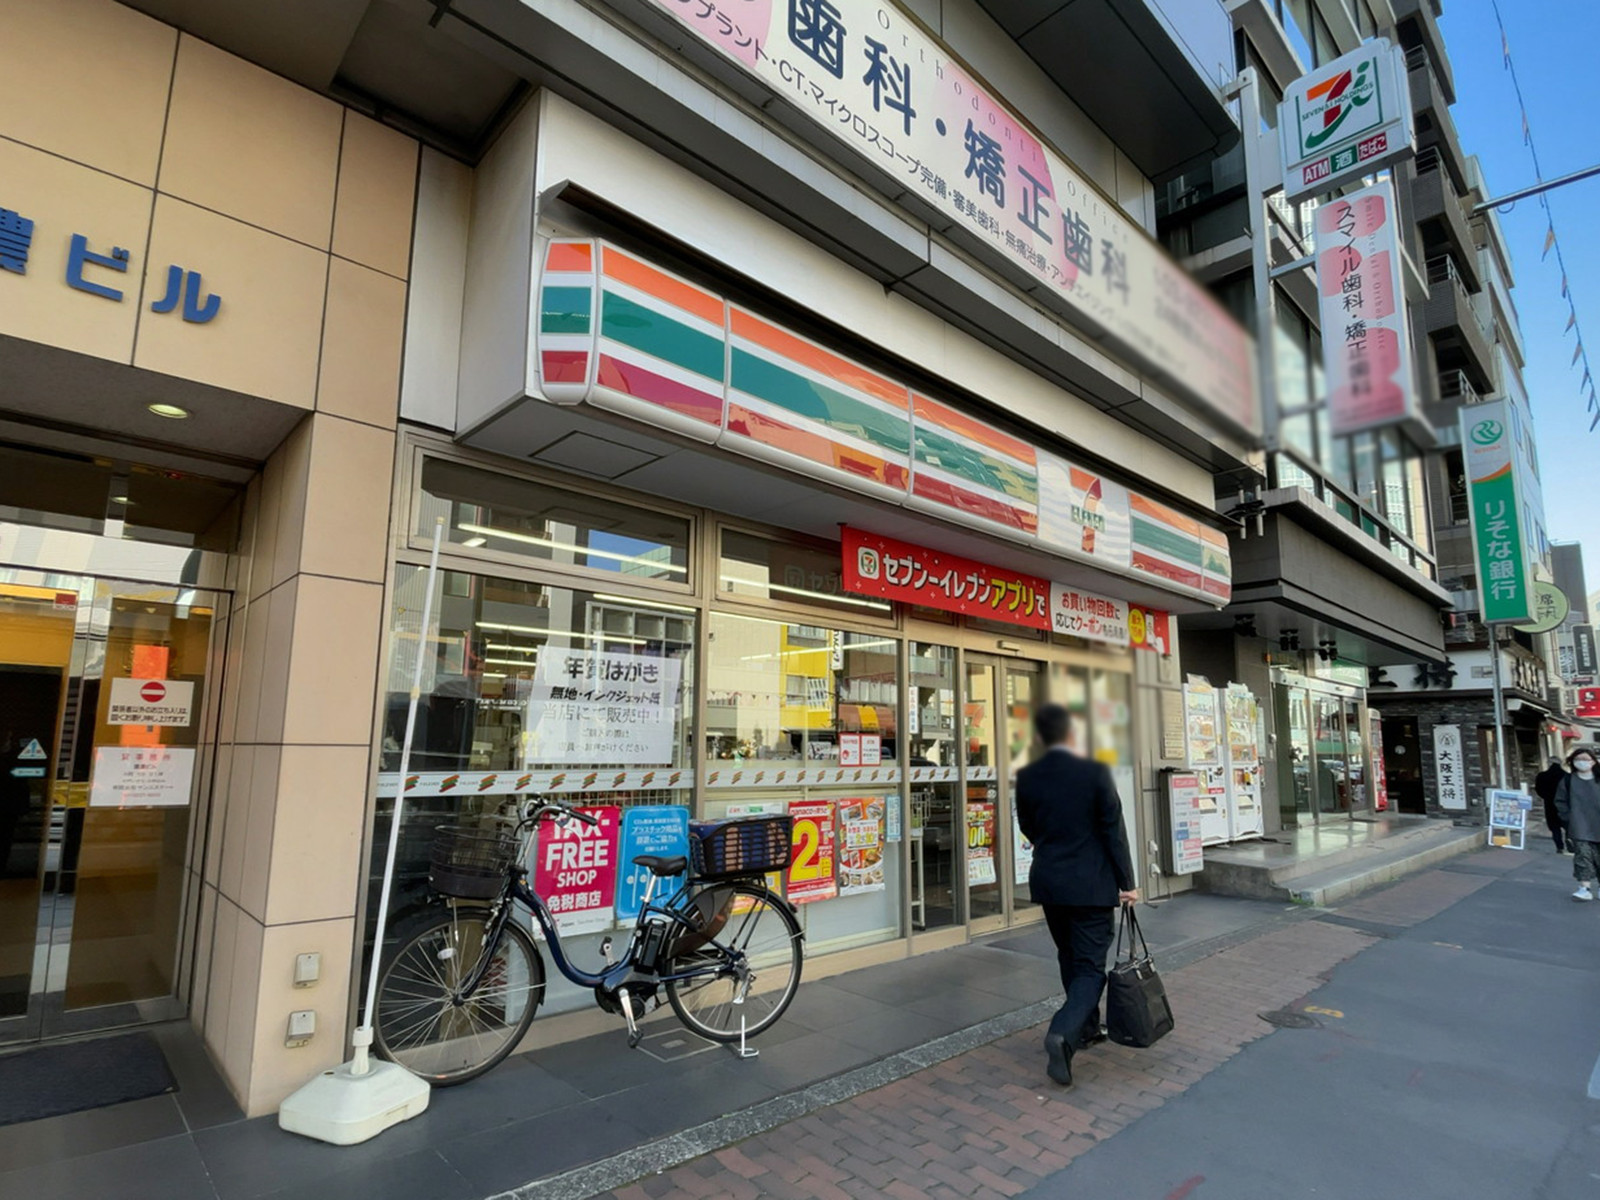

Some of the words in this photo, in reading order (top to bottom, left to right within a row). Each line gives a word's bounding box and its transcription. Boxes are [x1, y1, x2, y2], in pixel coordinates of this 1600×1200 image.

[1335, 150, 1352, 170] 酒
[1358, 136, 1388, 159] たばこ
[1304, 157, 1330, 183] ATM
[1484, 499, 1517, 600] りそな銀行
[1061, 591, 1121, 621] お買い物回数に
[562, 656, 659, 684] 年賀はがき
[1438, 749, 1457, 801] 大阪王将
[547, 809, 611, 839] TAX-
[544, 840, 610, 871] FREE
[556, 869, 597, 888] SHOP
